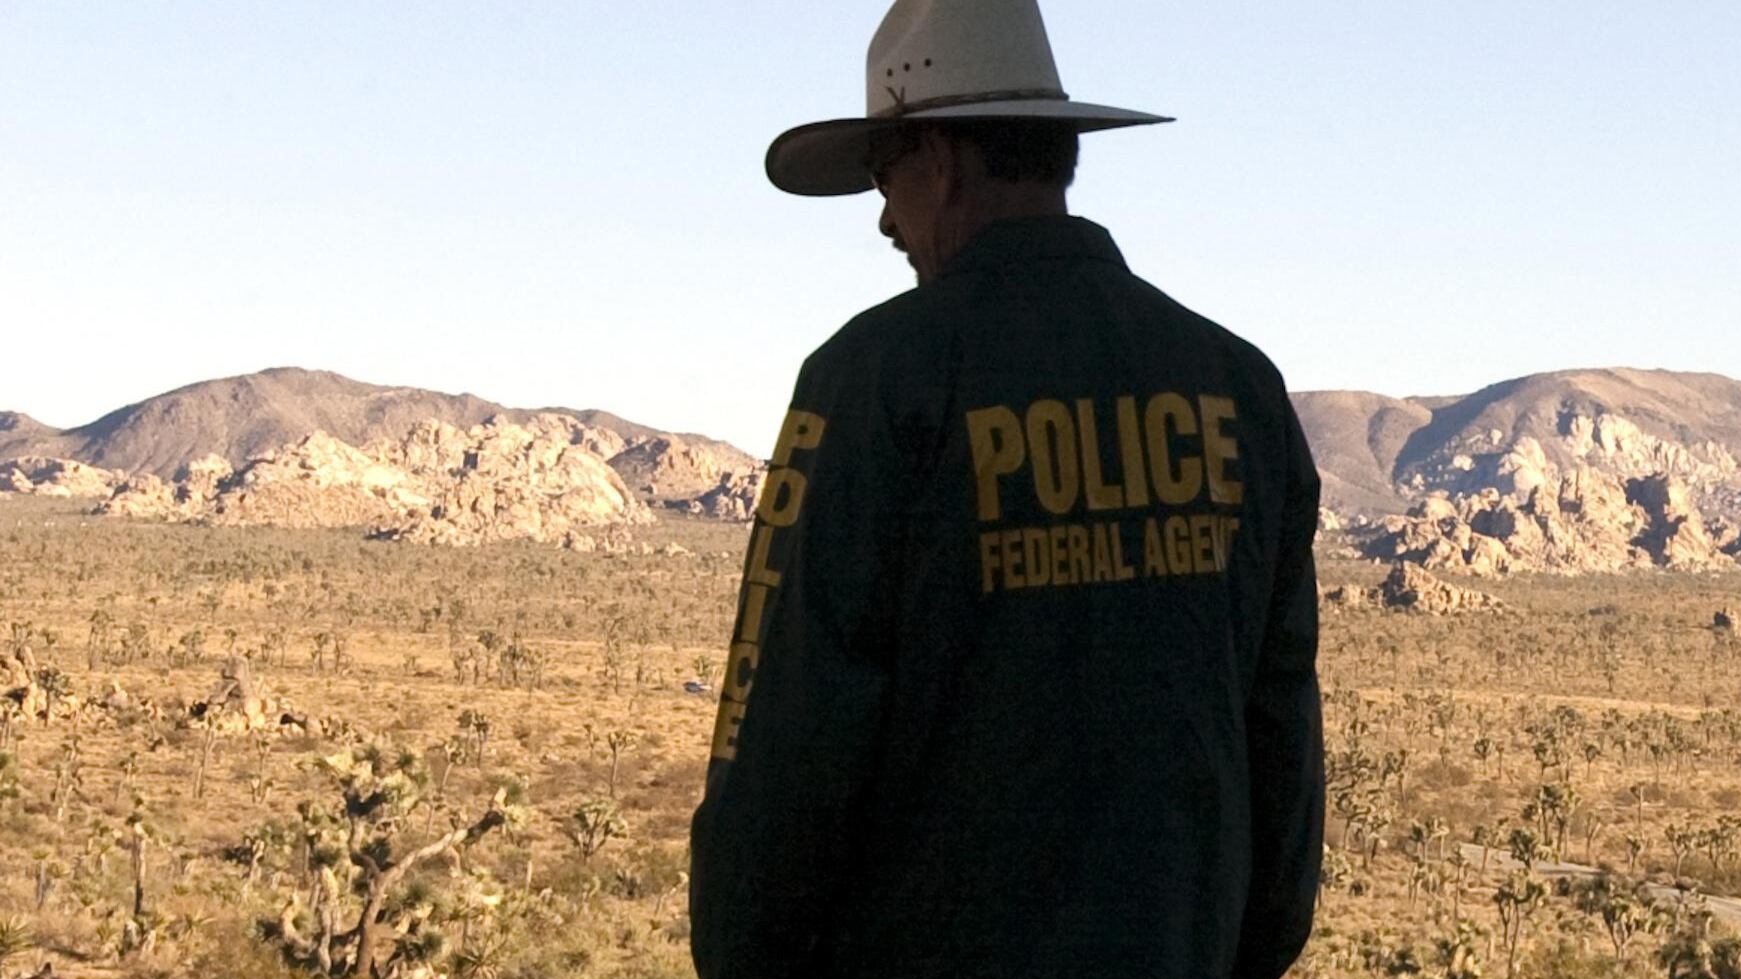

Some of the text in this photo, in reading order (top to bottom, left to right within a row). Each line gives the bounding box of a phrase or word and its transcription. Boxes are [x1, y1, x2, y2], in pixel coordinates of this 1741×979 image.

[966, 392, 1243, 520] POLICE
[711, 409, 826, 760] POLICE
[981, 522, 1135, 593] FEDERAL
